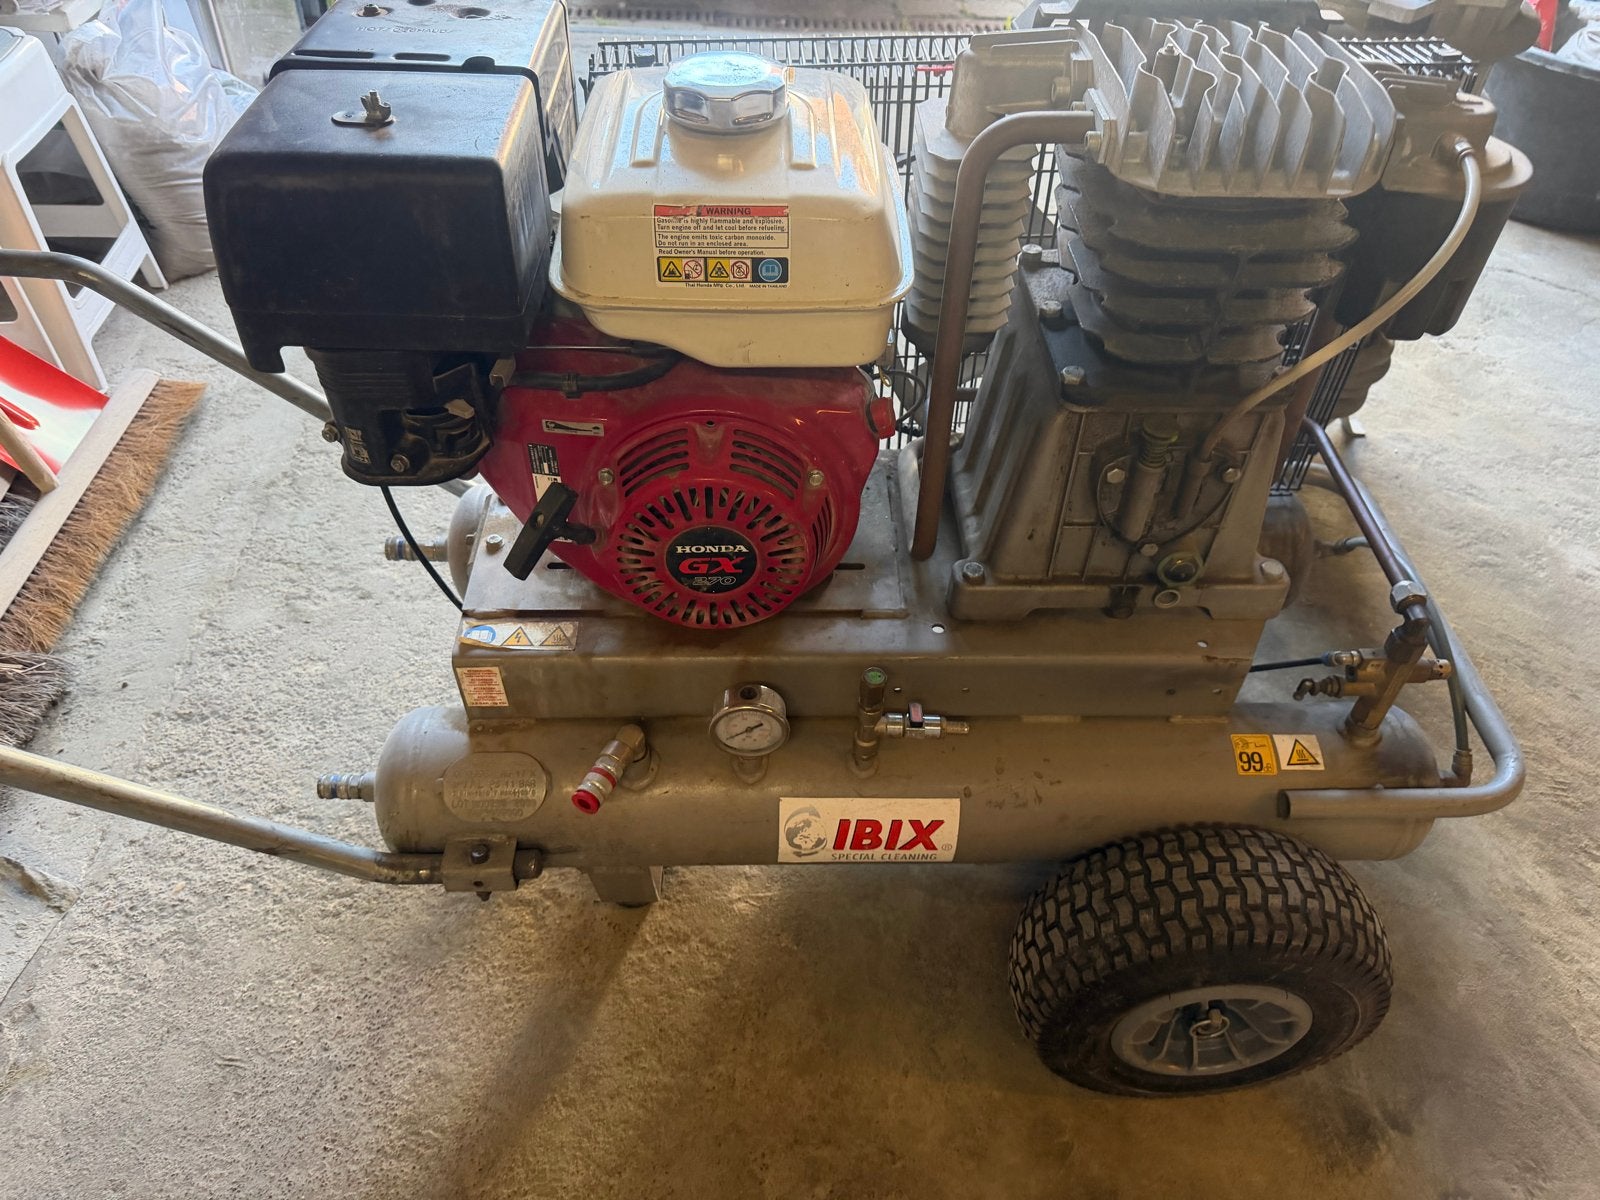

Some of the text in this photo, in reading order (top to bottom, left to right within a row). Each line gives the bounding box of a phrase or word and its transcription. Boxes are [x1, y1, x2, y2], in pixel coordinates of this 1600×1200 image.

[676, 545, 749, 554] HONDA
[678, 557, 745, 574] GX
[693, 576, 736, 586] 270
[1238, 752, 1264, 772] 99
[832, 818, 944, 850] IBIX
